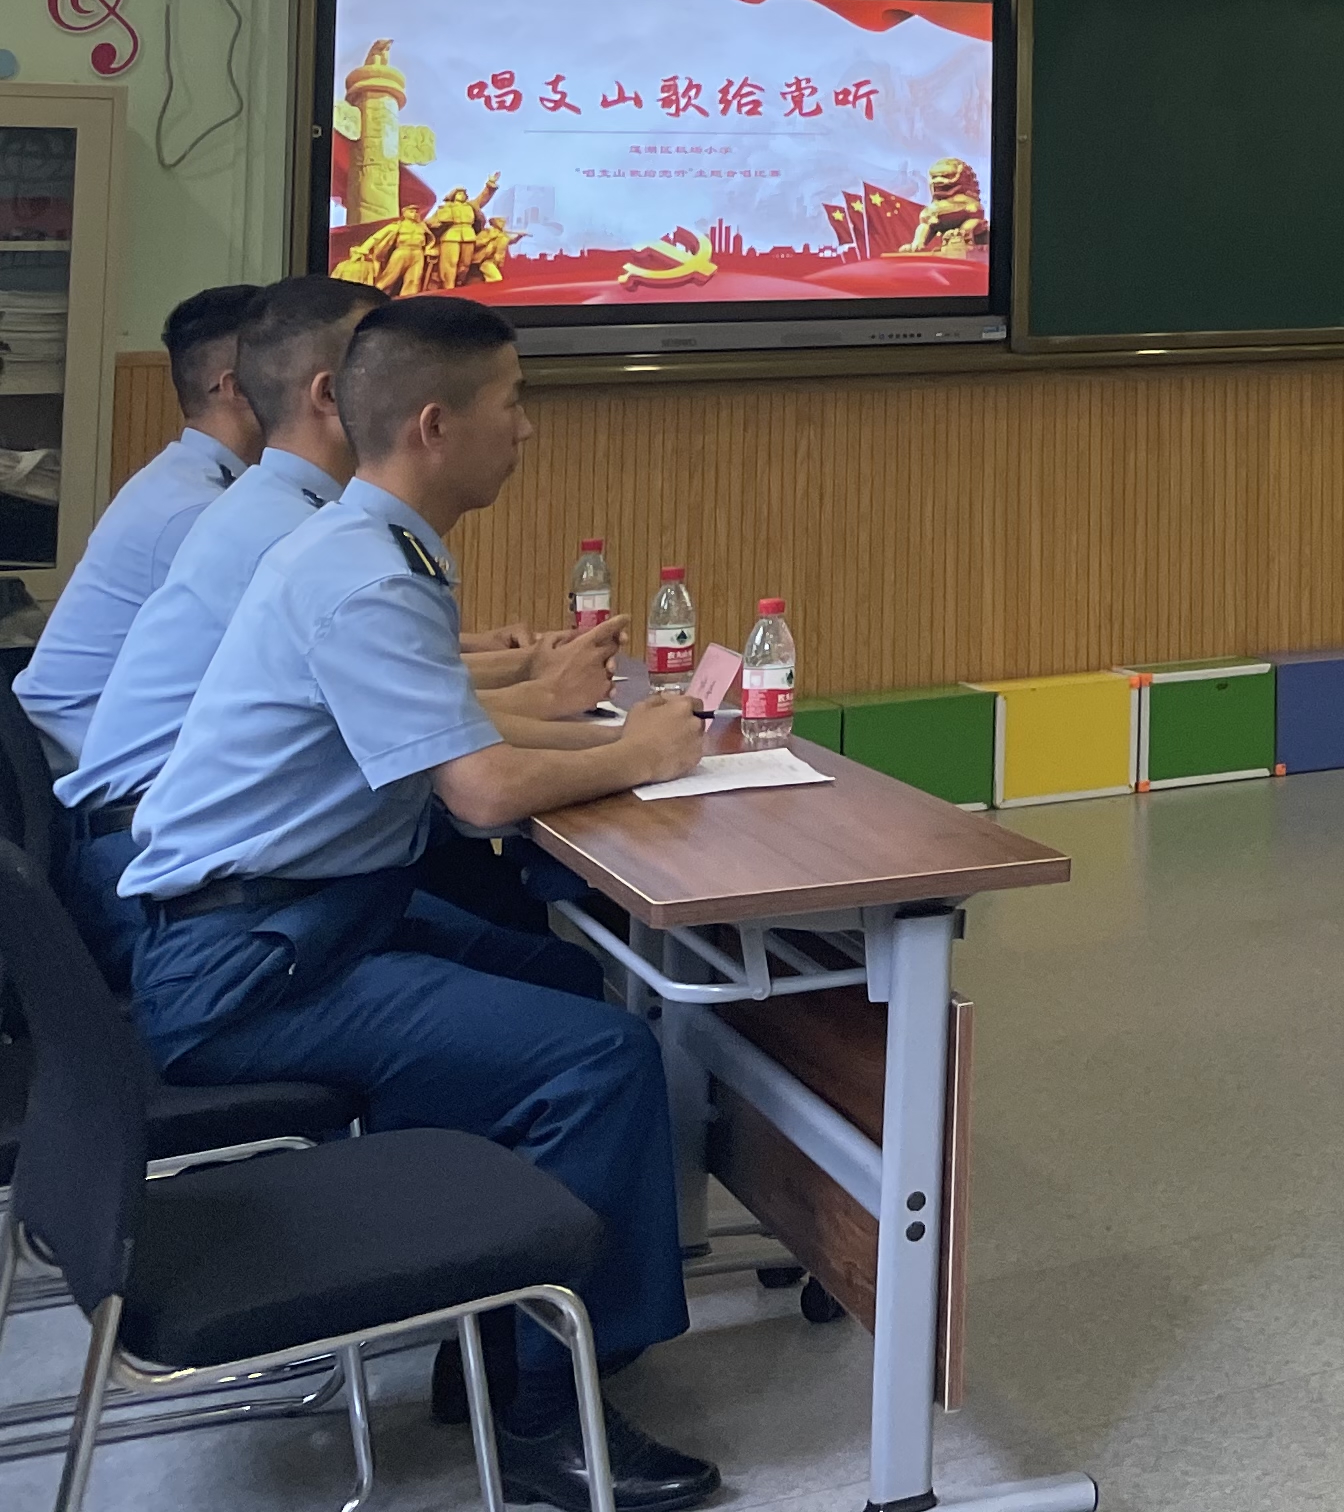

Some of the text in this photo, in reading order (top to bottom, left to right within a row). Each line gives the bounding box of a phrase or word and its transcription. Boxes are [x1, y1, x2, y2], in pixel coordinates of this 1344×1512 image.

[466, 70, 880, 121] 唱支山歌给党听
